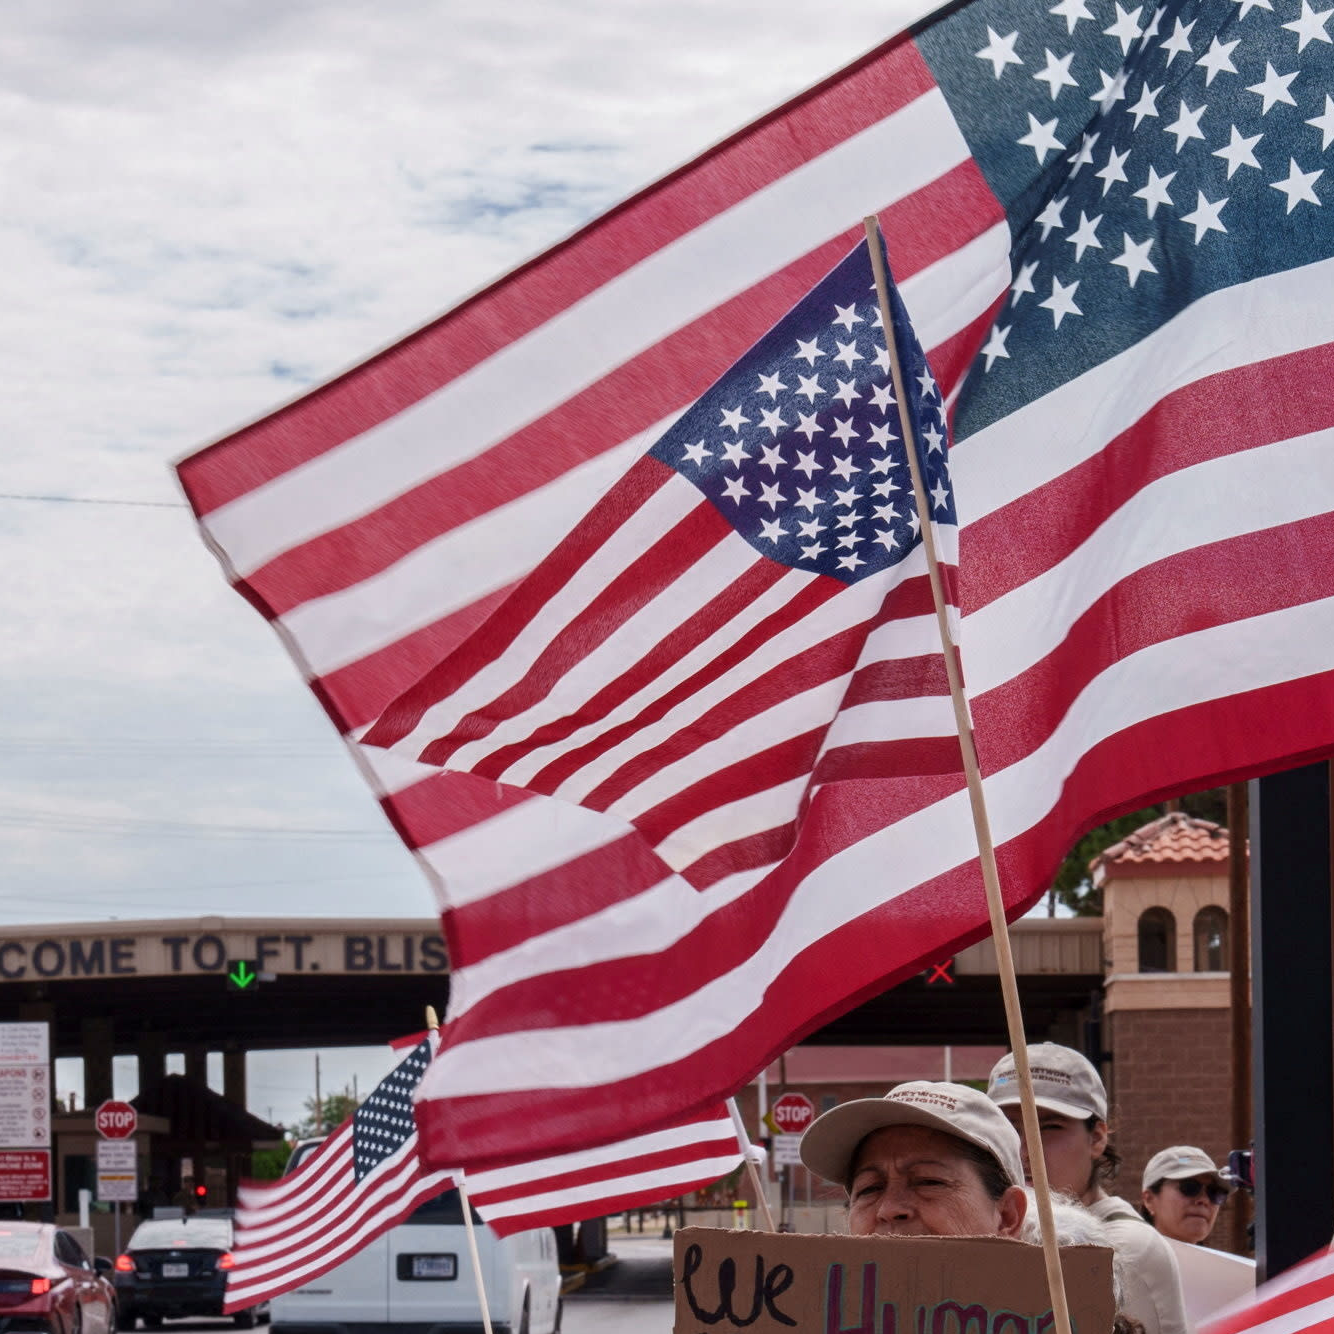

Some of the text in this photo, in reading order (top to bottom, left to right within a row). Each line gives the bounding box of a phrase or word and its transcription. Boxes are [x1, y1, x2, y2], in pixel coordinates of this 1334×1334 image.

[161, 935, 227, 972] TO
[254, 935, 320, 972] FT.
[344, 936, 449, 972] BLIS
[99, 1111, 134, 1128] STOP
[776, 1105, 811, 1122] STOP
[680, 1243, 798, 1328] We
